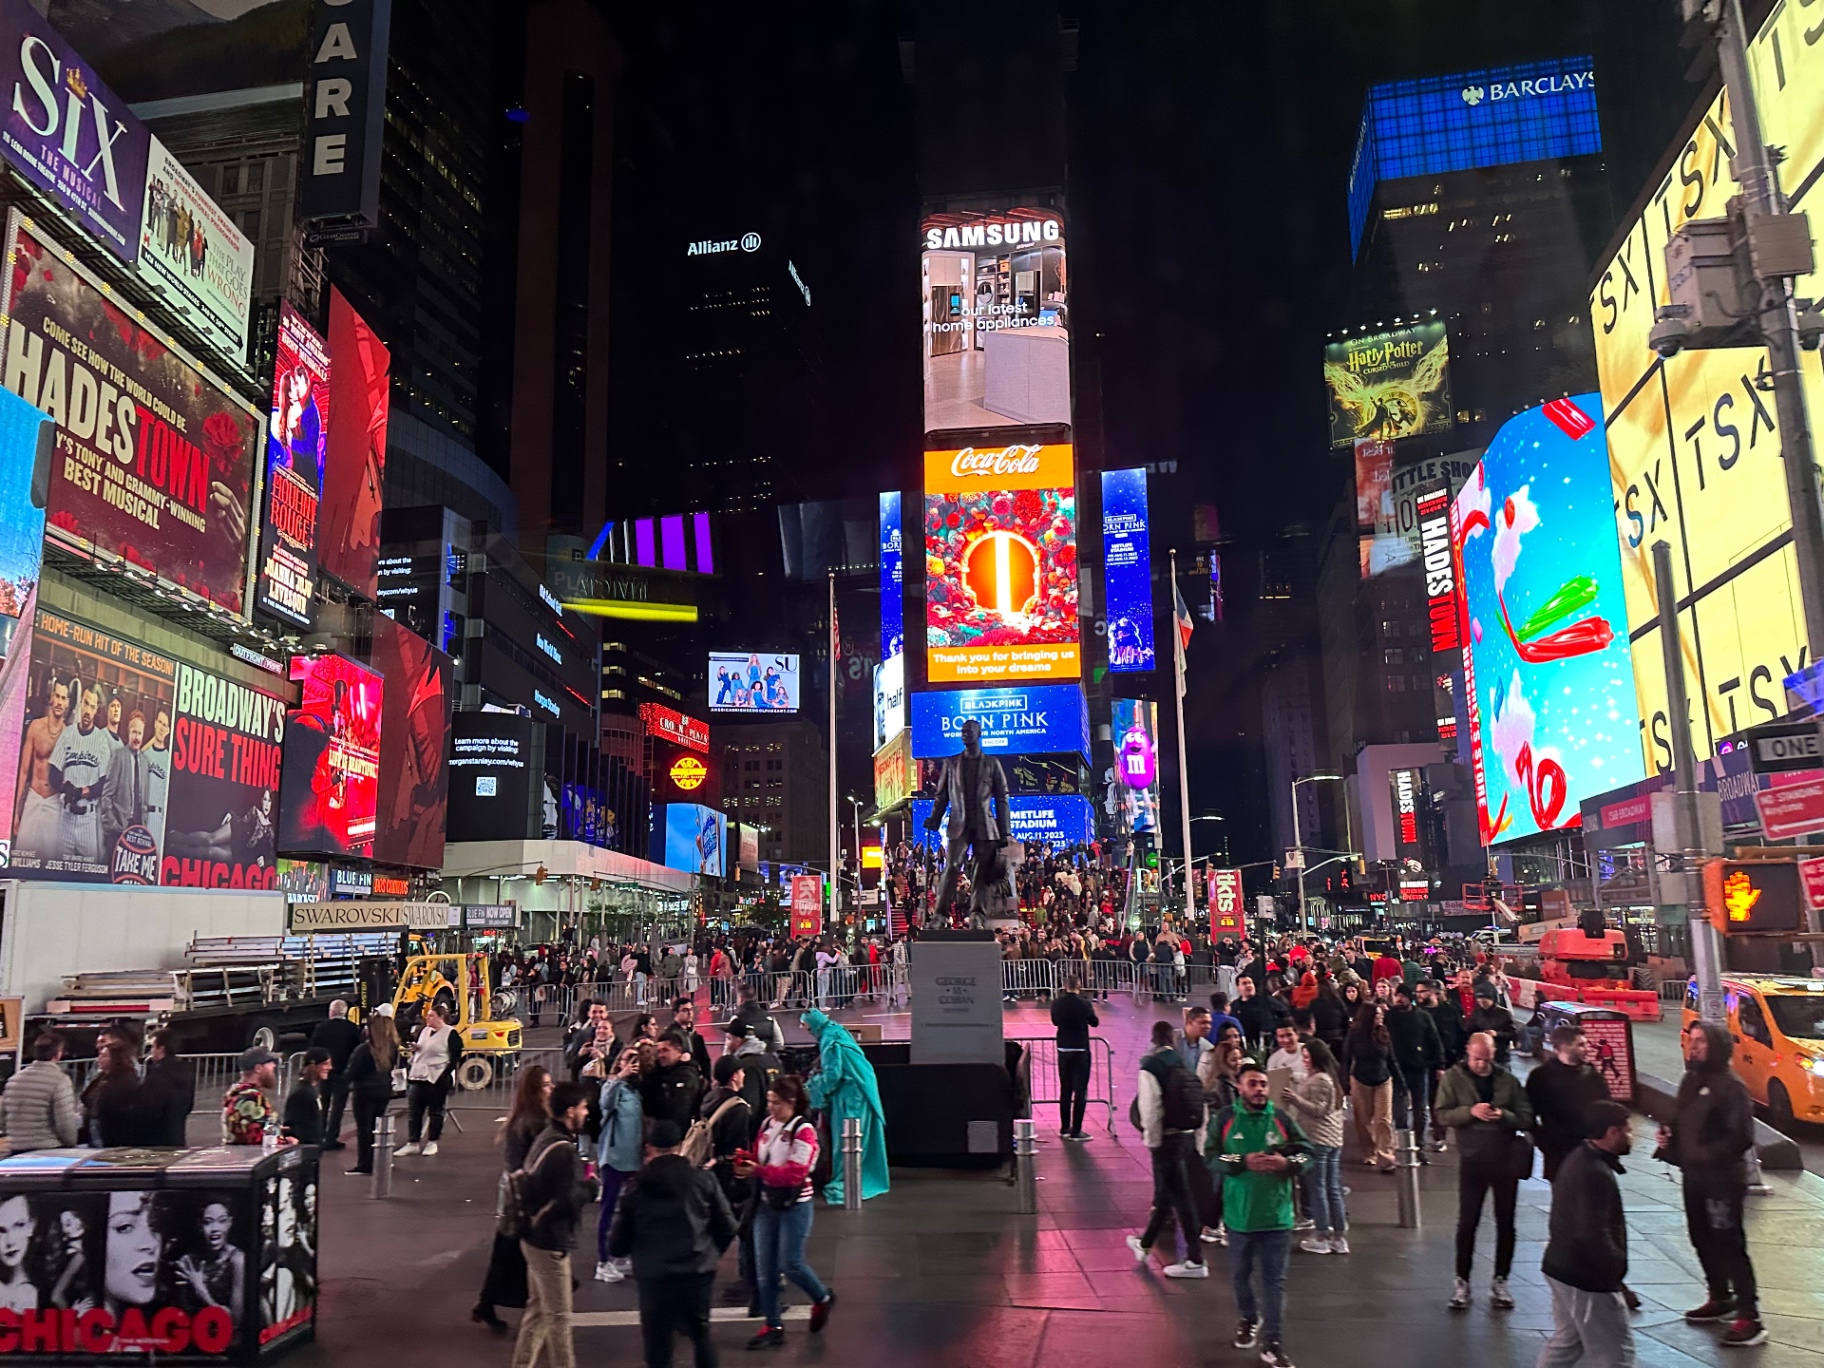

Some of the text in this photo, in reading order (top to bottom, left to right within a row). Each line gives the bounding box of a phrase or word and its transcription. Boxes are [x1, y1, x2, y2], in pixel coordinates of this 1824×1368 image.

[312, 0, 357, 176] ARE
[1490, 71, 1595, 101] BARCLAYS
[13, 36, 128, 212] SIX
[41, 144, 101, 211] THE MUSICAL
[164, 157, 196, 194] BROADWAY'S
[1655, 94, 1738, 234] TSX
[162, 166, 174, 181] AND
[173, 178, 210, 221] INTERNATIONAL
[687, 239, 738, 256] Allianz
[926, 219, 1060, 250] SAMSUNG
[208, 252, 226, 275] THAT
[225, 270, 248, 300] GOES
[225, 254, 246, 282] PLAY
[207, 264, 247, 318] WRONG
[1590, 236, 1640, 335] SX
[961, 301, 1028, 318] our latest
[932, 318, 973, 334] home
[1350, 326, 1417, 346] ON BROADWAY
[1346, 340, 1424, 372] Harry Potter
[1389, 360, 1410, 370] CHILD
[42, 315, 188, 434] COME SEE HOW THE WORLD COULD BE.
[4, 319, 210, 514] HADESTOWN
[1685, 355, 1776, 491] TSX
[104, 454, 125, 486] AND
[950, 444, 1044, 478] Coca-Cola
[63, 457, 160, 530] BEST MUSICAL
[1615, 458, 1668, 548] SX
[1103, 523, 1121, 531] ORN
[1124, 519, 1147, 530] PINK
[1421, 516, 1459, 652] HADESTOWN
[41, 614, 93, 646] HOME-RUN
[93, 633, 110, 651] HIT
[111, 638, 123, 655] OF
[124, 646, 140, 663] THE
[142, 654, 174, 676] SEASON!
[933, 650, 1075, 664] Thank you for bringing us
[956, 662, 1052, 675] into your dreams
[177, 664, 286, 744] BROADWAY'S
[886, 686, 903, 711] half
[1002, 711, 1049, 729] PINK
[173, 717, 282, 792] SURE THING
[455, 745, 486, 753] campaign
[487, 745, 497, 753] by
[490, 738, 509, 746] about
[509, 739, 519, 747] the
[1772, 737, 1817, 758] ONE
[1473, 748, 1487, 808] STORE
[1717, 771, 1761, 802] BROADWA
[1009, 809, 1055, 819] METLIFE
[1396, 770, 1418, 844] HADESTOWN
[11, 857, 41, 869] WILLIAMS
[45, 860, 64, 870] JESSE
[64, 861, 82, 872] TYLER
[115, 845, 157, 882] TAKE ME
[161, 854, 277, 889] CHICAGO
[336, 870, 372, 886] BLUE FIN
[1216, 873, 1237, 912] tkts
[294, 907, 400, 924] SWAROVSKI
[403, 905, 449, 926] SWAROVSKI
[486, 907, 499, 918] NOW
[499, 907, 512, 918] OPEN
[0, 1306, 234, 1353] CHICAGO
